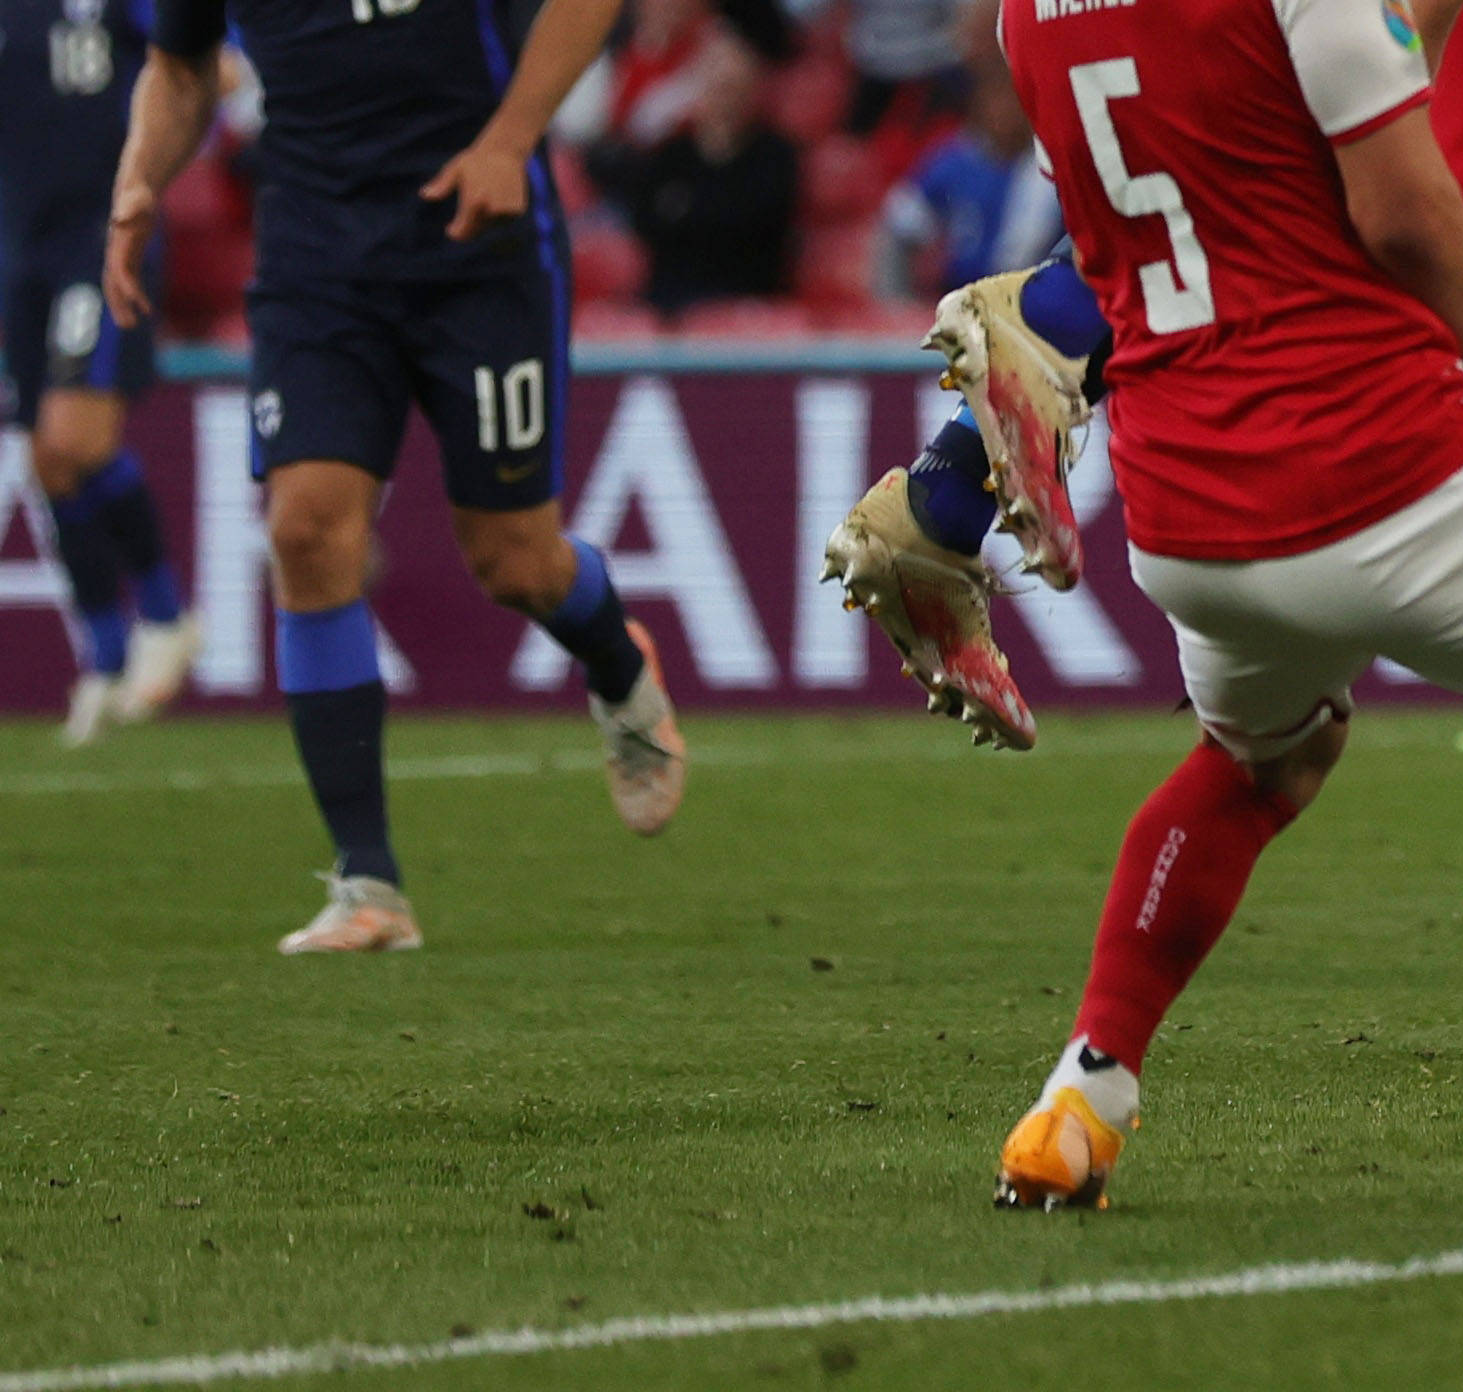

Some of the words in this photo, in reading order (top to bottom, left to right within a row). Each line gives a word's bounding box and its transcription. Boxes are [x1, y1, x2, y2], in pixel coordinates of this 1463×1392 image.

[48, 23, 114, 95] 18
[1068, 56, 1216, 335] 5
[474, 358, 545, 452] 10
